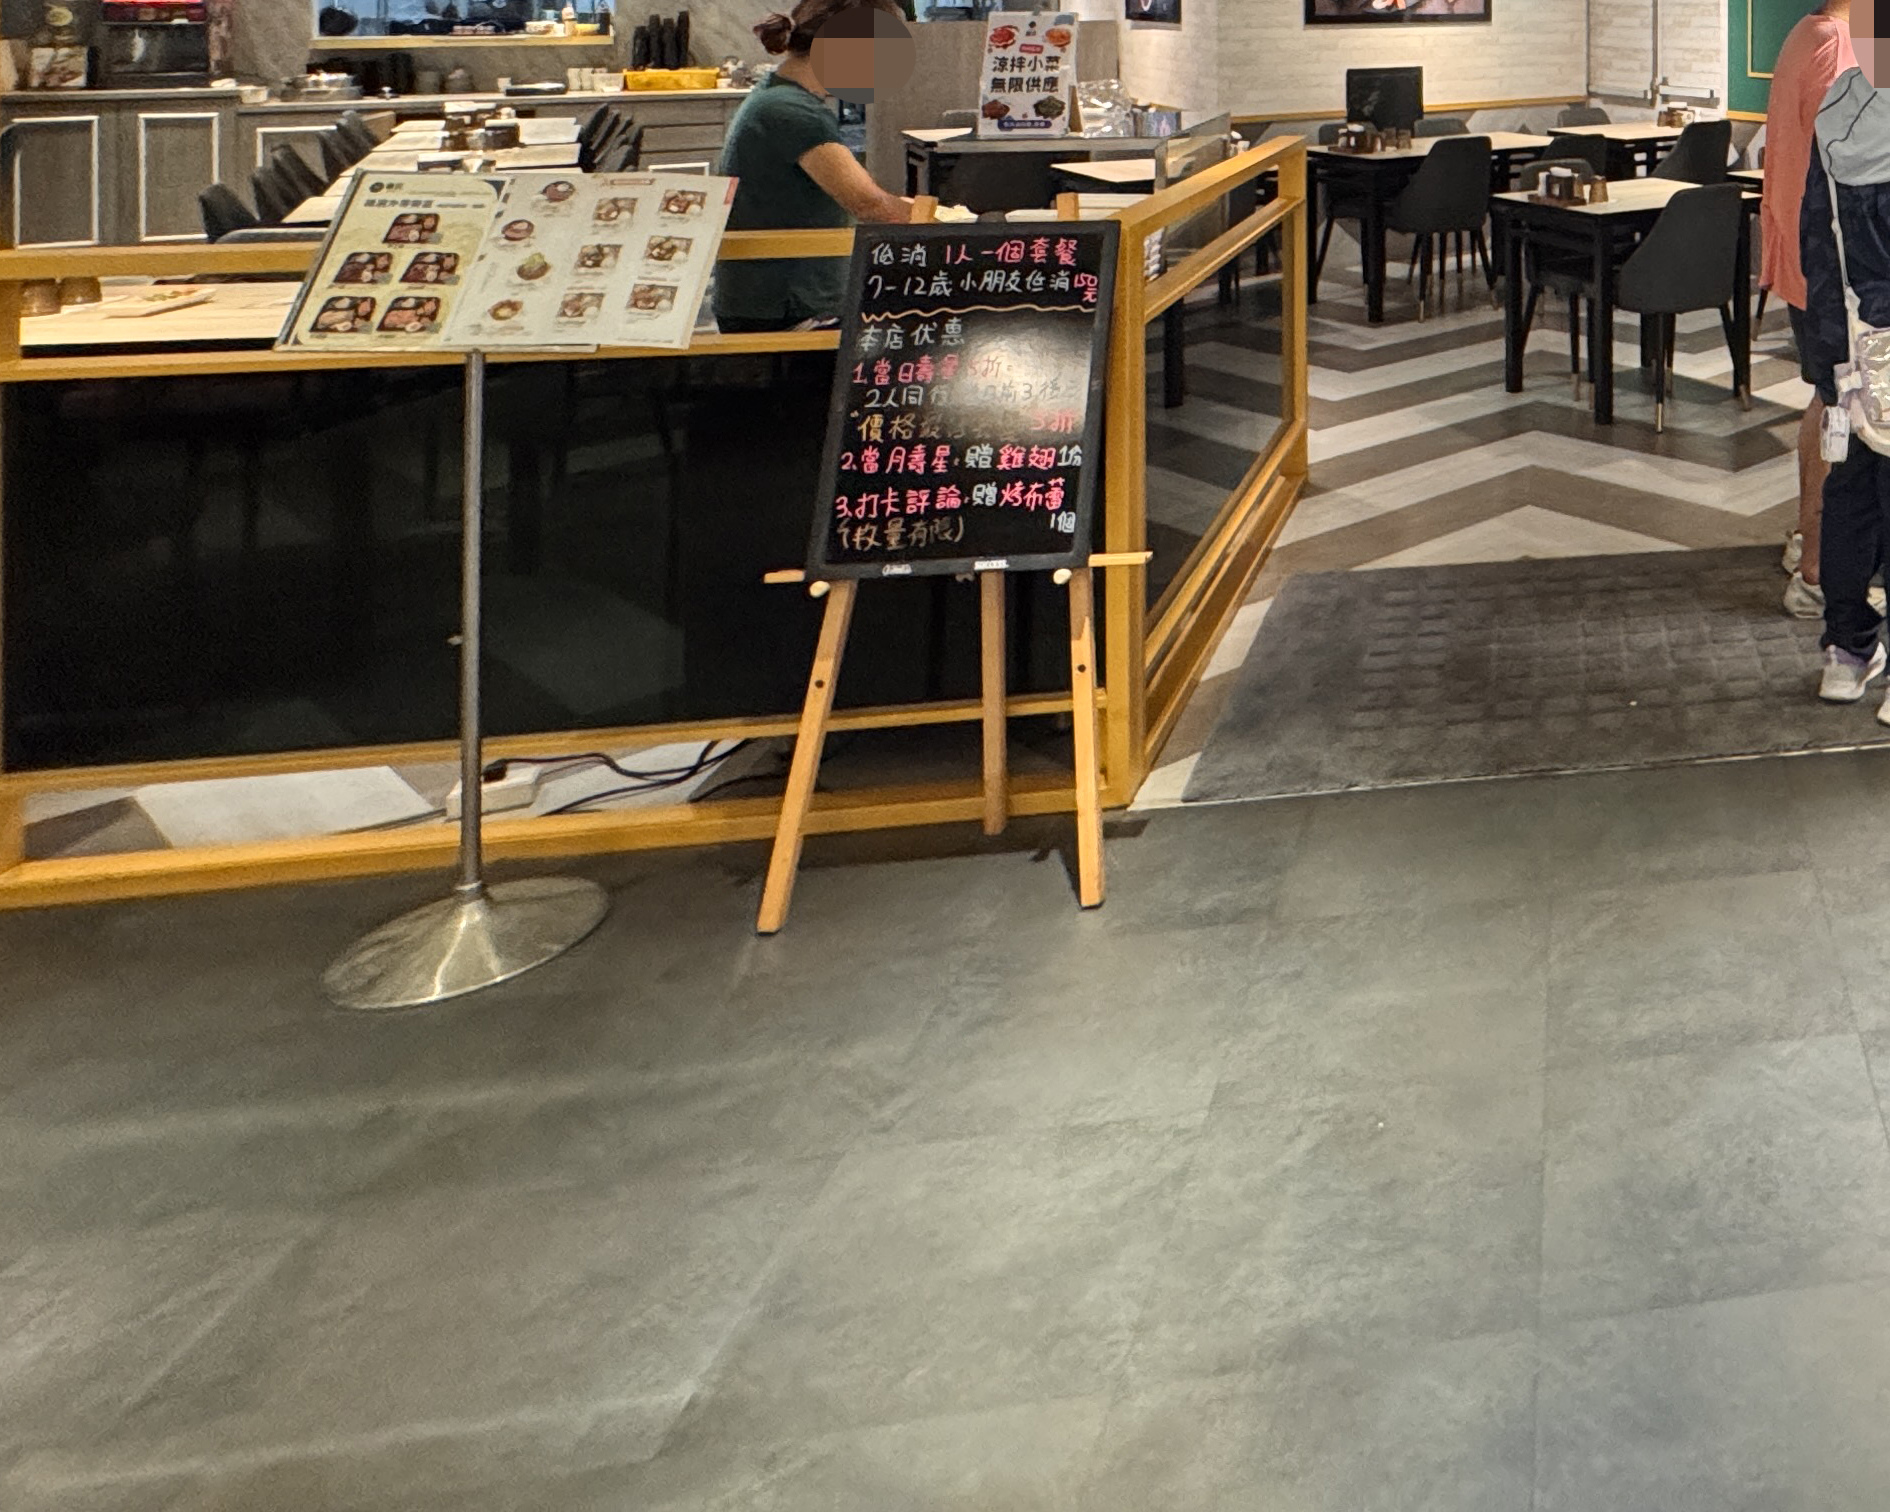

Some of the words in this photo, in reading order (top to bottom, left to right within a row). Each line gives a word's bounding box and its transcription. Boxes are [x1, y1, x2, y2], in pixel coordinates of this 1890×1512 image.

[992, 55, 1061, 74] 涼拌小菜
[990, 76, 1060, 93] 無限供應
